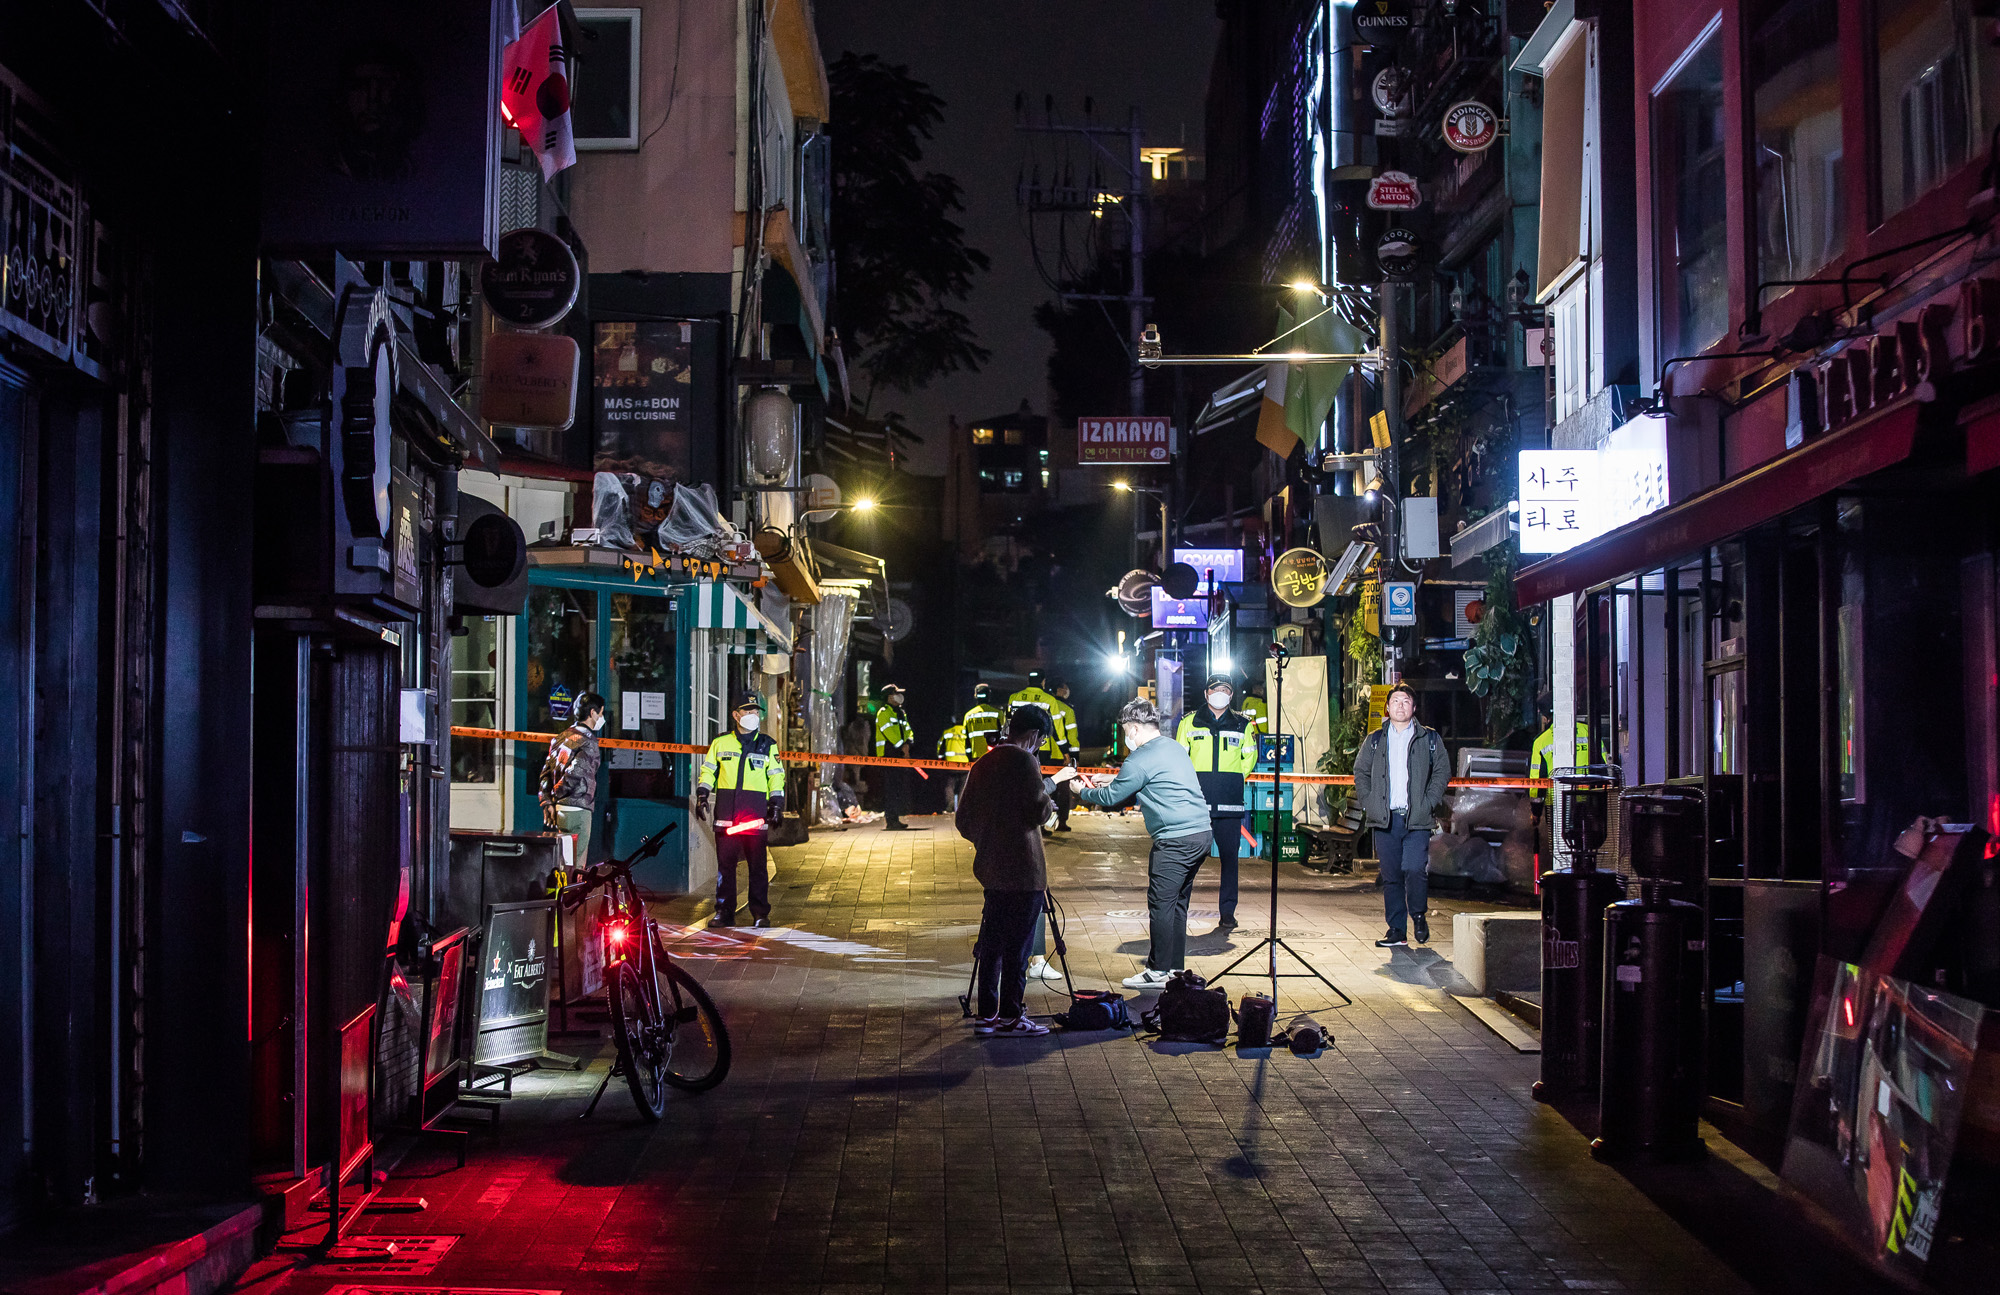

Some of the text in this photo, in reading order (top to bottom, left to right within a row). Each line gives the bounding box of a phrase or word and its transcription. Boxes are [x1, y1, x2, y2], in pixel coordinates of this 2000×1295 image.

[1357, 15, 1408, 27] GUINNESS
[1449, 107, 1491, 124] ERDINGER
[1384, 231, 1415, 242] GOOSE
[604, 398, 633, 409] MAS
[651, 397, 680, 409] BON
[607, 411, 677, 421] KUSI CUISINE
[1082, 421, 1166, 442] IZAKAYA
[1153, 449, 1164, 458] 2F
[1526, 466, 1580, 492] 사주
[1526, 506, 1580, 532] 타로
[1277, 570, 1327, 597] 꿀밤
[1177, 603, 1186, 614] 2
[1266, 746, 1287, 760] CAS
[1281, 846, 1300, 855] TERRA
[514, 964, 524, 979] FAT
[525, 960, 545, 976] ALBERT'S
